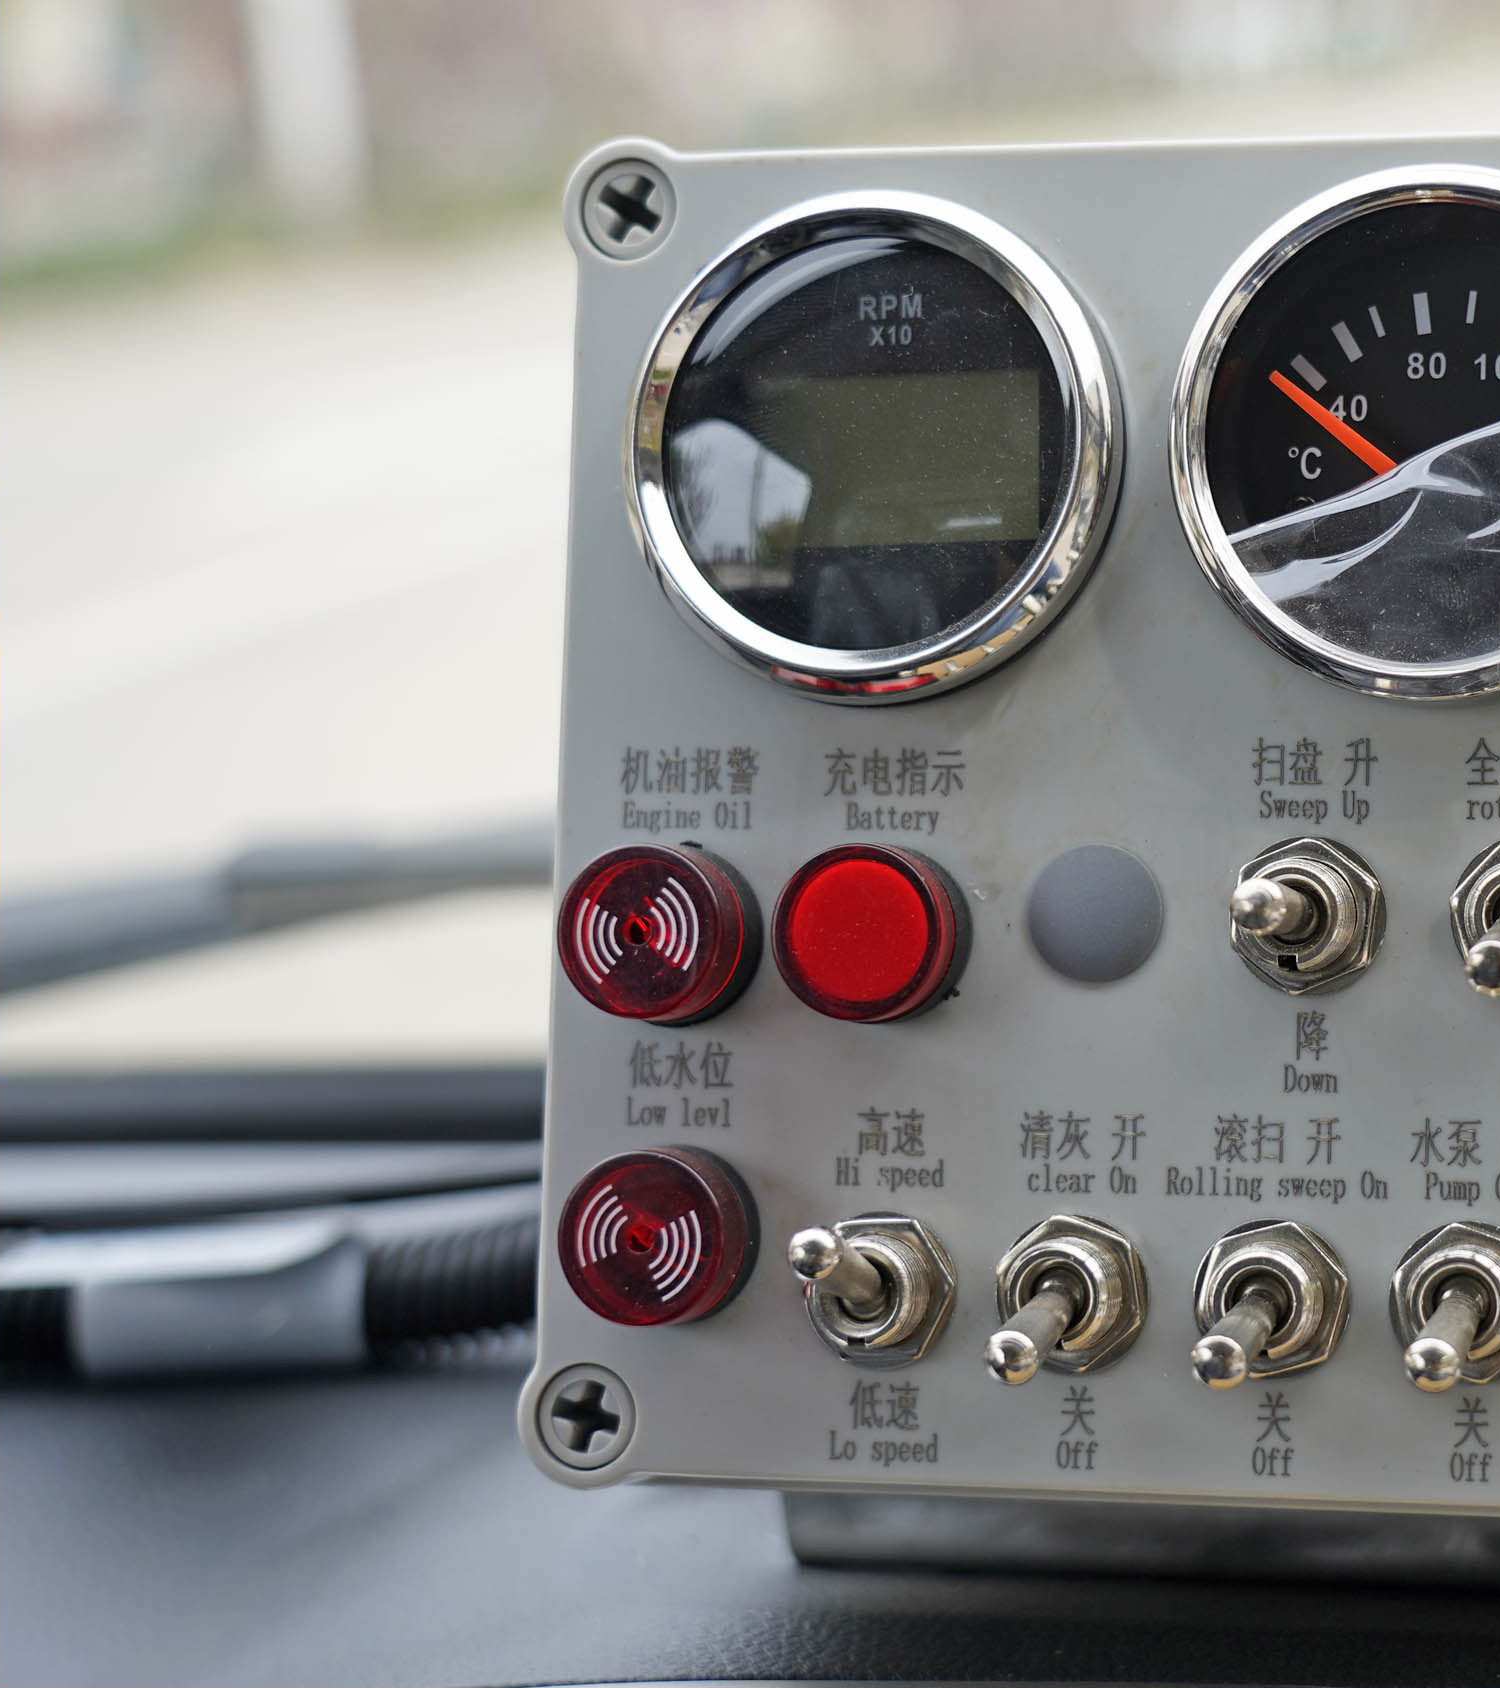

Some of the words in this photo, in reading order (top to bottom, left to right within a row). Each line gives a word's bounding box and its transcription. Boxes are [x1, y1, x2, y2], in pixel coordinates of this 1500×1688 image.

[857, 292, 925, 321] RPM
[1407, 352, 1447, 379] 80
[1328, 395, 1367, 421] 40
[621, 746, 760, 796] 机油报警
[824, 747, 966, 797] 充电指示
[1252, 737, 1323, 786] 扫盘
[1344, 738, 1378, 787] 升
[622, 803, 701, 835] Engine
[715, 803, 752, 830] Oil
[846, 803, 940, 836] Battery
[1260, 790, 1328, 824] Sweep
[1342, 790, 1370, 825] Up
[1296, 1010, 1328, 1061] 降
[630, 1040, 734, 1090] 低水位
[1283, 1064, 1338, 1093] Down
[626, 1096, 667, 1126] Low
[857, 1107, 926, 1158] 高速
[1020, 1110, 1091, 1160] 清灰
[1112, 1114, 1146, 1161] 开
[1214, 1114, 1285, 1164] 滚扫
[1306, 1117, 1341, 1165] 开
[1410, 1117, 1482, 1168] 水泵
[835, 1157, 861, 1187] Hi
[877, 1160, 944, 1193] speed
[1027, 1165, 1096, 1194] clear
[1110, 1165, 1136, 1194] On
[1166, 1167, 1264, 1203] Rolling
[1278, 1178, 1346, 1204] sweep
[1361, 1170, 1388, 1200] On
[1424, 1172, 1480, 1207] Pump
[849, 1379, 920, 1431] 低速
[1060, 1386, 1095, 1438] 关
[1256, 1392, 1291, 1443] 关
[1453, 1396, 1489, 1449] 关
[829, 1431, 857, 1461] Lo
[870, 1434, 939, 1468] speed
[1056, 1440, 1099, 1470] Off
[1252, 1446, 1294, 1477] Off
[1450, 1451, 1493, 1483] Off
